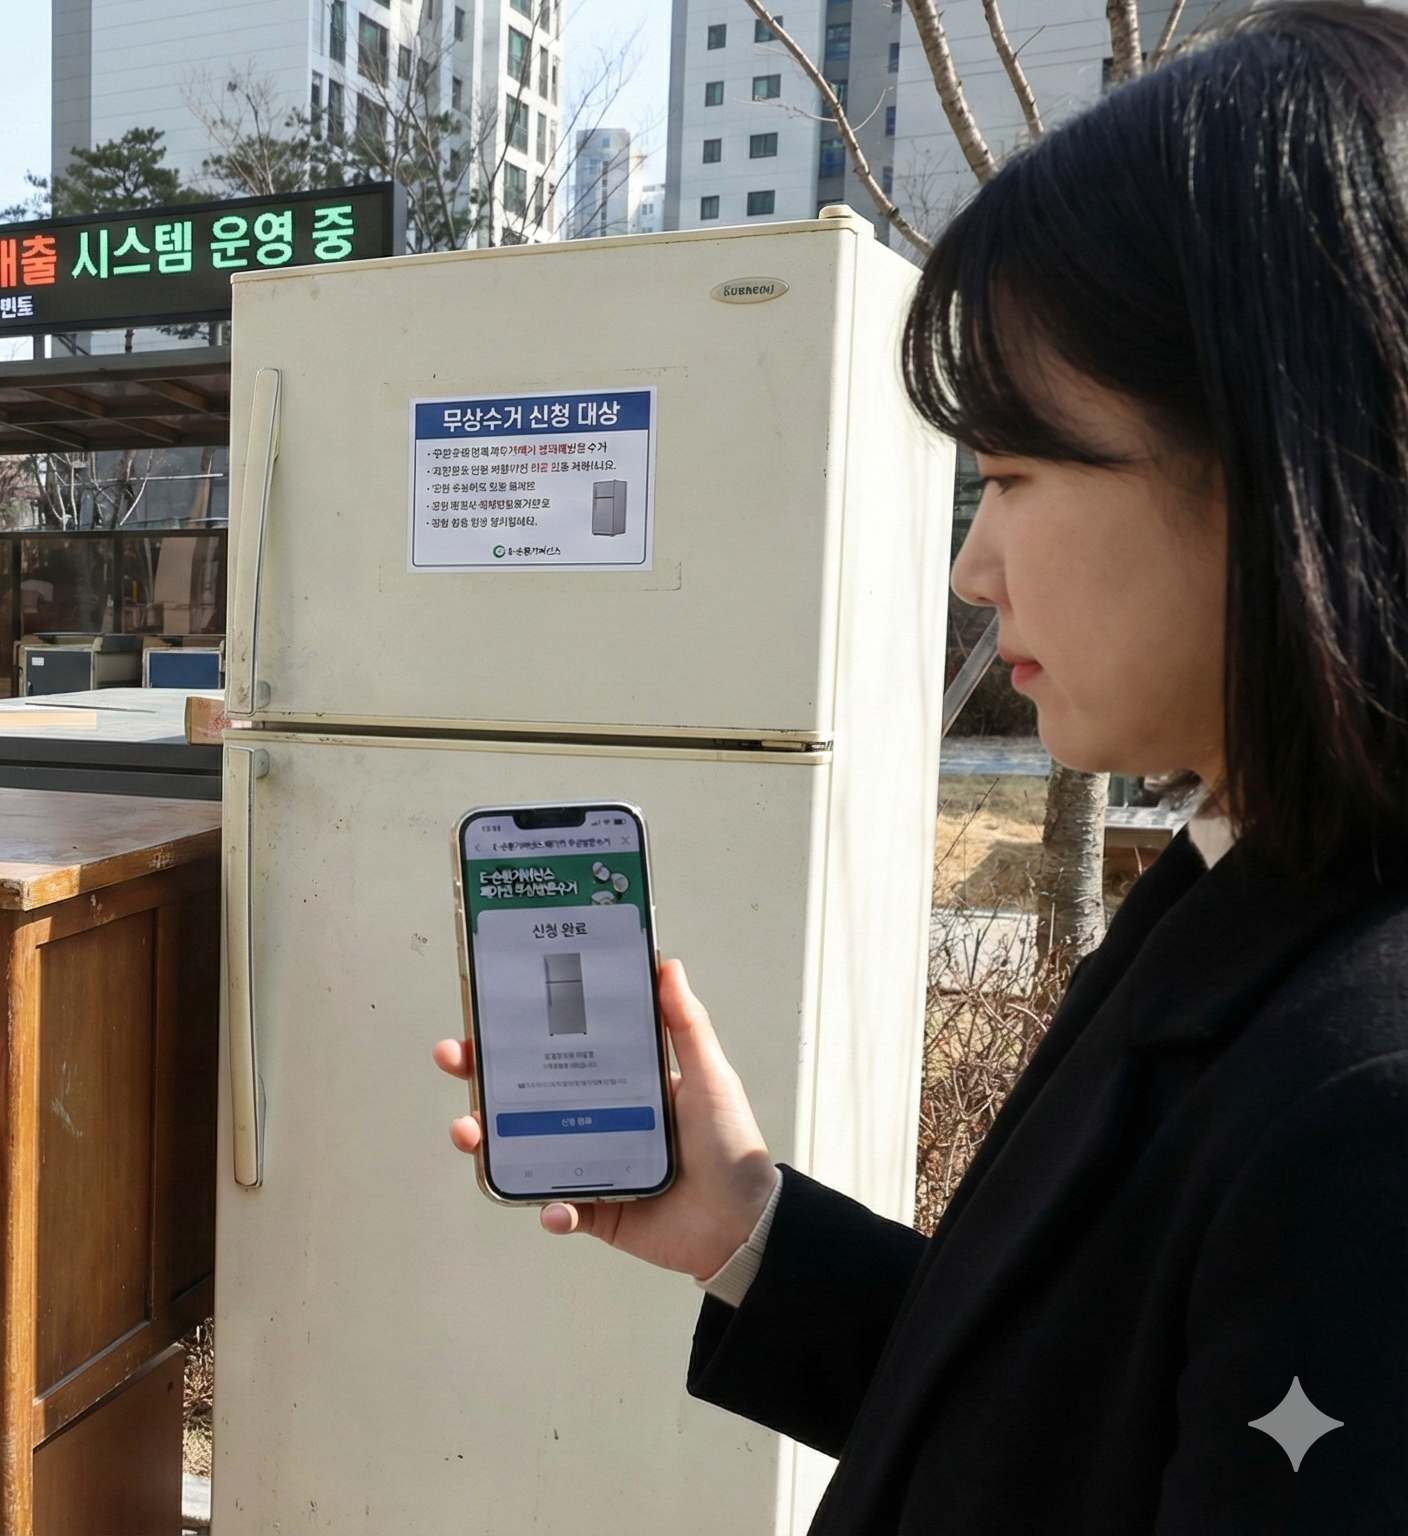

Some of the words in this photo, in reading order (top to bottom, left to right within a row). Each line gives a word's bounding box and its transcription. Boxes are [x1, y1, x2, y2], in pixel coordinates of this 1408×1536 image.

[71, 220, 194, 281] 시스템
[210, 209, 294, 269] 운영
[312, 204, 355, 261] 중
[443, 406, 522, 432] 무상수거
[529, 402, 570, 428] 신청
[578, 400, 621, 426] 대상
[533, 923, 558, 939] 신청
[561, 922, 588, 938] 완료
